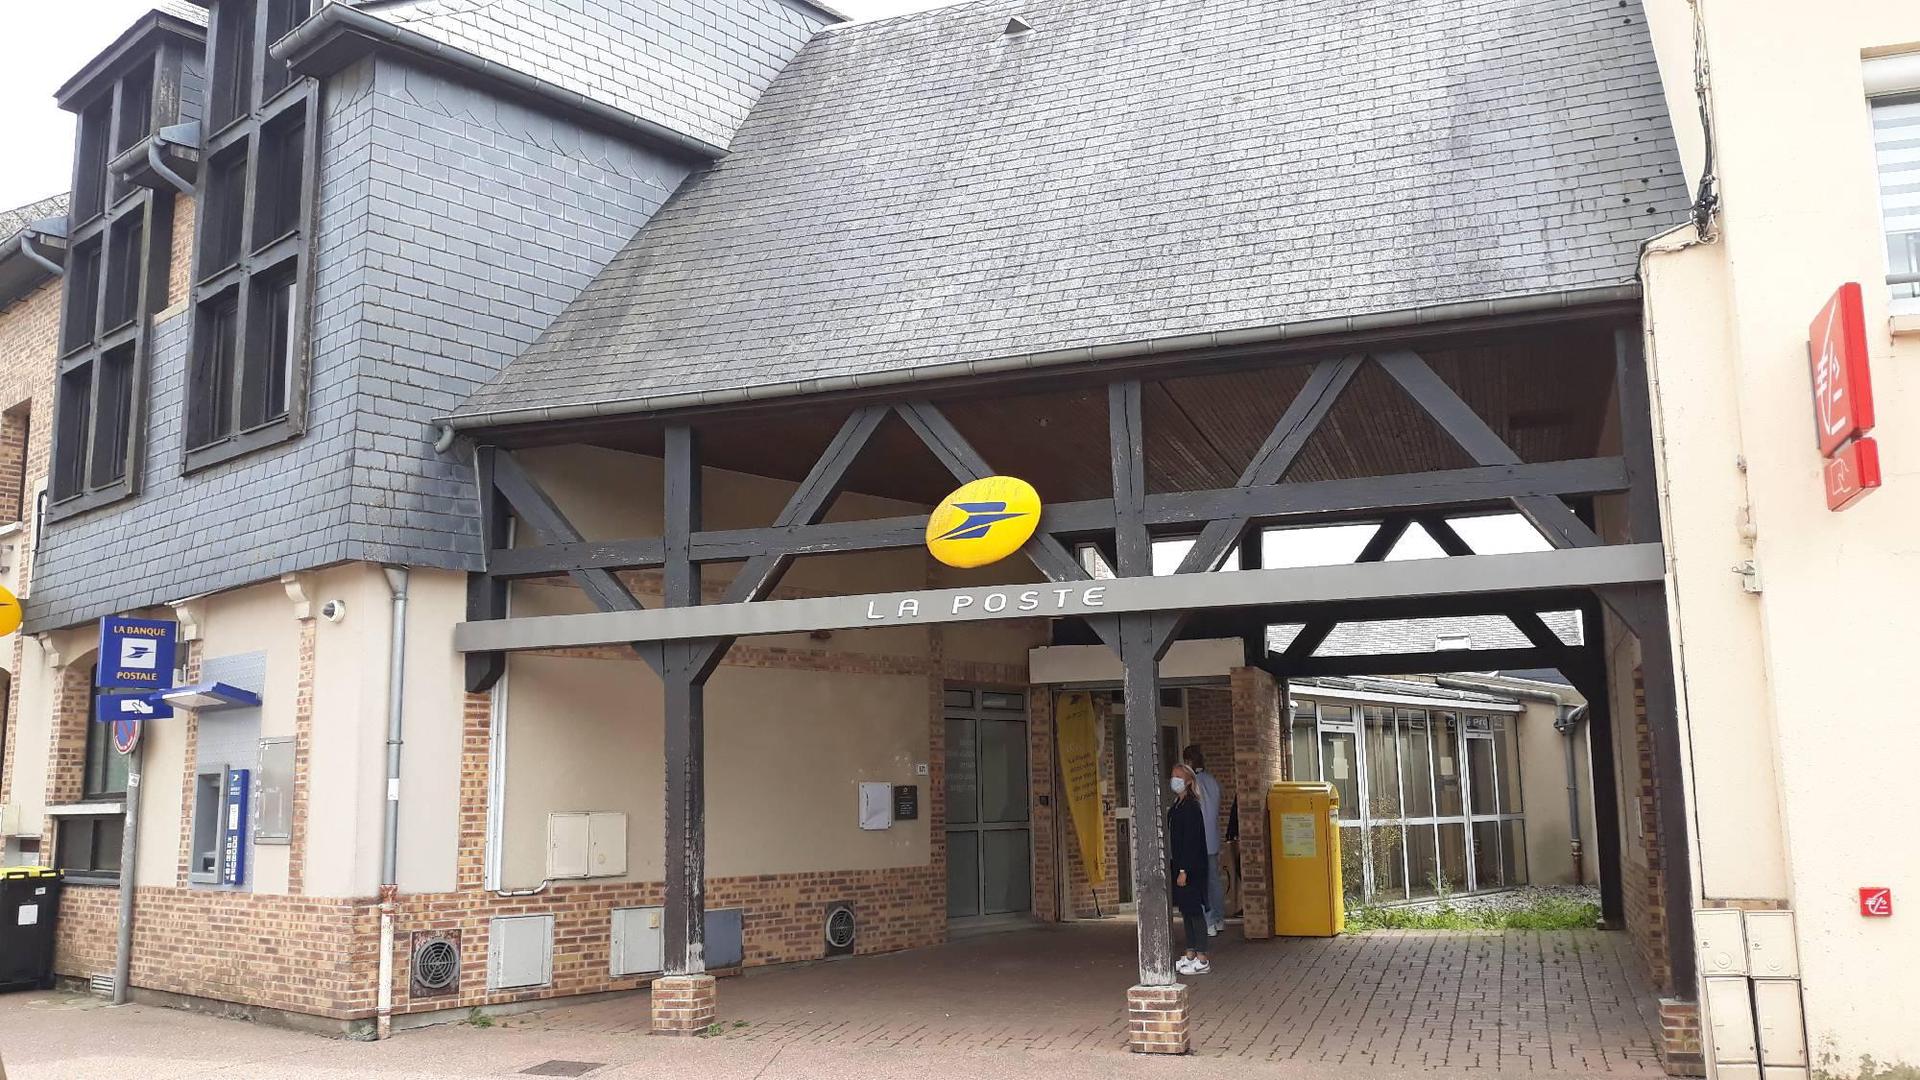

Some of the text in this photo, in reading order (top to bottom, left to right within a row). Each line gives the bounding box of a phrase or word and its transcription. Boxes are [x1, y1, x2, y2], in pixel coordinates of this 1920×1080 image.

[867, 586, 1106, 619] LA POSTE
[113, 625, 166, 637] LA BANQUE
[116, 671, 157, 681] POSTALE
